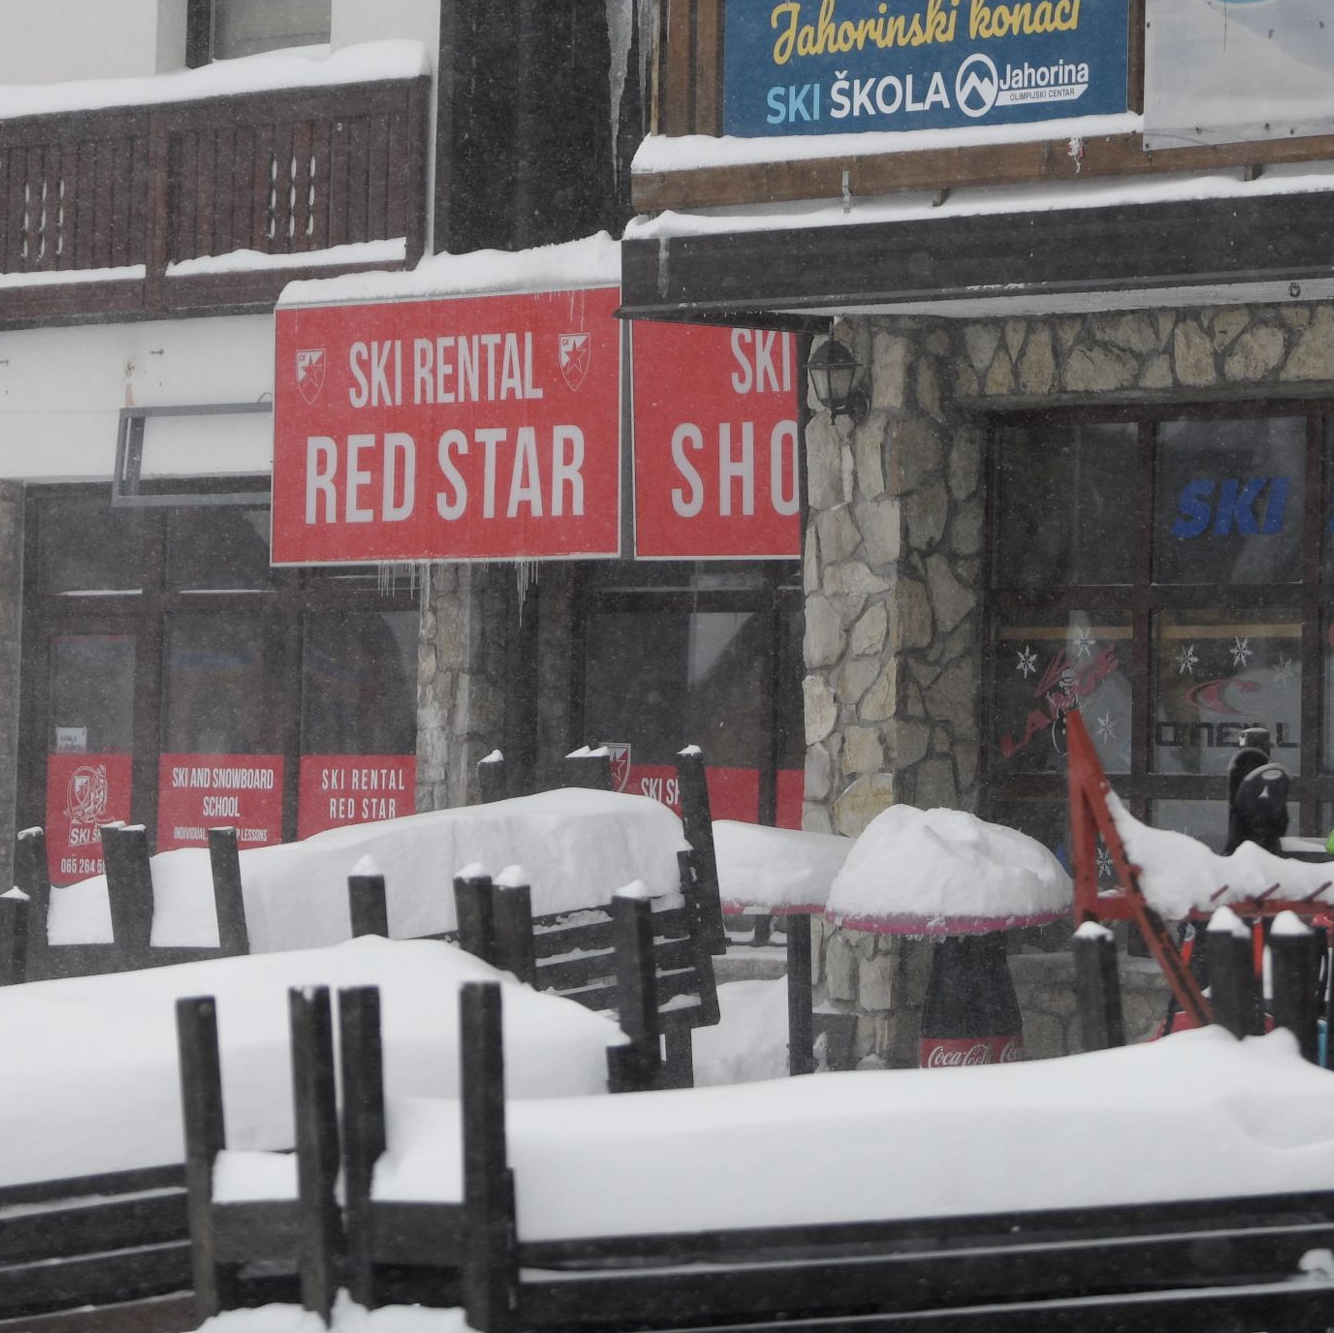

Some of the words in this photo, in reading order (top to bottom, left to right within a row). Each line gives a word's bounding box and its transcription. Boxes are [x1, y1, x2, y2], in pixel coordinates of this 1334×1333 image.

[998, 58, 1089, 90] Jahorina
[766, 83, 820, 125] SKI
[829, 69, 951, 120] ŠKOLA
[1009, 90, 1047, 101] OLIMPIJSKI
[1048, 88, 1075, 98] CENTAR
[349, 339, 403, 408] SKI
[414, 331, 543, 405] RENTAL
[730, 327, 792, 394] SKI
[304, 432, 417, 525] RED
[435, 423, 586, 522] STAR
[670, 419, 800, 518] SHO
[1170, 476, 1292, 540] SKI
[172, 767, 190, 788] SKI
[190, 767, 210, 788] AND
[212, 768, 274, 789] SNOWBOARD
[322, 768, 345, 790] SKI
[351, 768, 405, 790] RENTAL
[640, 777, 663, 803] SKI
[202, 795, 240, 817] SCHOOL
[329, 797, 355, 819] RED
[361, 797, 396, 819] STAR
[69, 827, 91, 844] SKI
[241, 828, 268, 842] LESSONS
[60, 857, 77, 874] 065
[78, 857, 96, 874] 264
